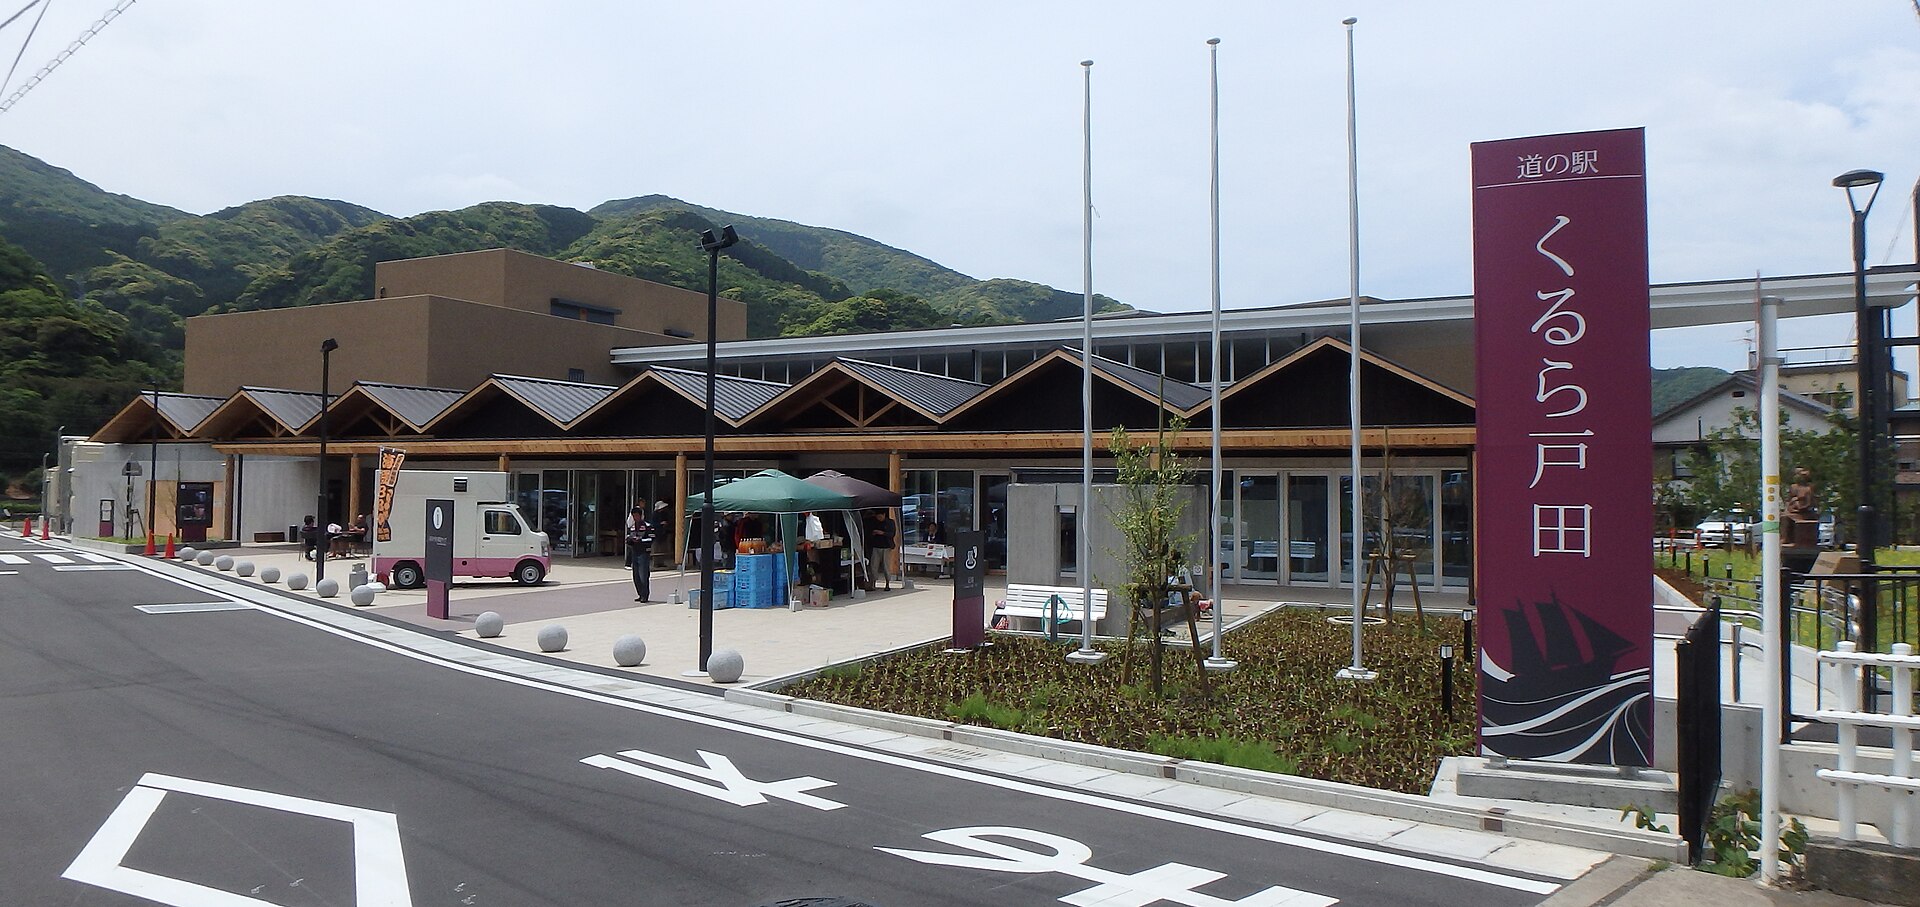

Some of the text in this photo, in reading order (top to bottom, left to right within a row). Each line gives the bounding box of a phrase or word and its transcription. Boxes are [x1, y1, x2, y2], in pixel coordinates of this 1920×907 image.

[1517, 149, 1599, 180] 道の駅
[1528, 214, 1595, 558] くるら戸田
